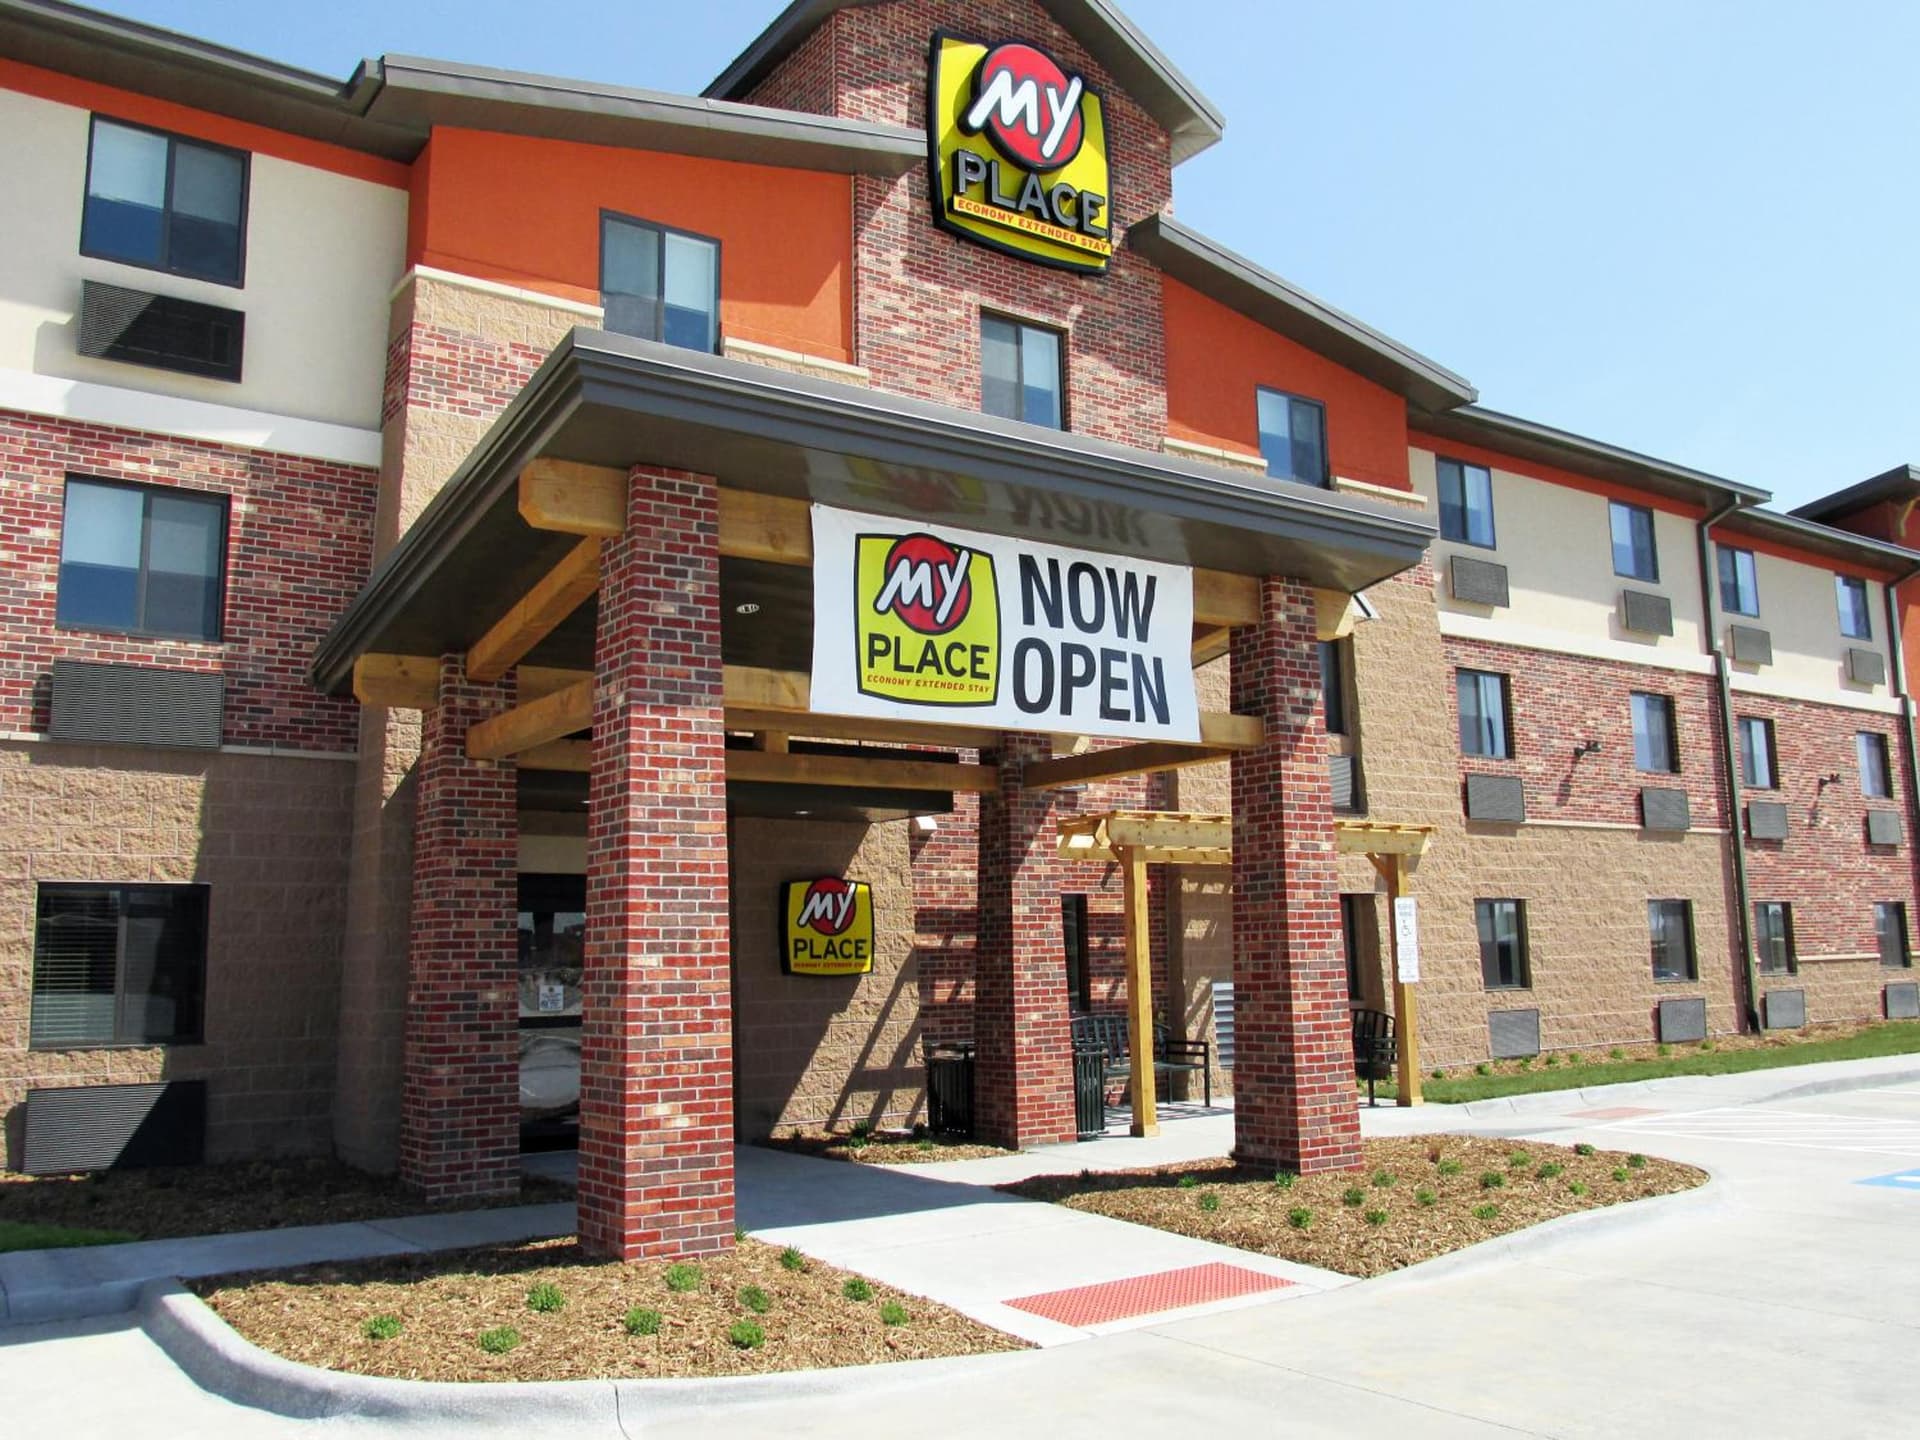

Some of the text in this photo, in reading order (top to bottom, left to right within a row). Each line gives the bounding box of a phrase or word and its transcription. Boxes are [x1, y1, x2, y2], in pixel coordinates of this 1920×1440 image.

[954, 149, 1108, 235] PLACE
[957, 199, 1108, 253] ECONOMY EXTENDED STAY
[1018, 553, 1157, 643] NOW
[866, 674, 991, 693] ECONOMY EXTENDED STAY
[867, 633, 990, 680] PLACE
[1012, 637, 1171, 725] OPEN
[793, 938, 867, 960] PLACE
